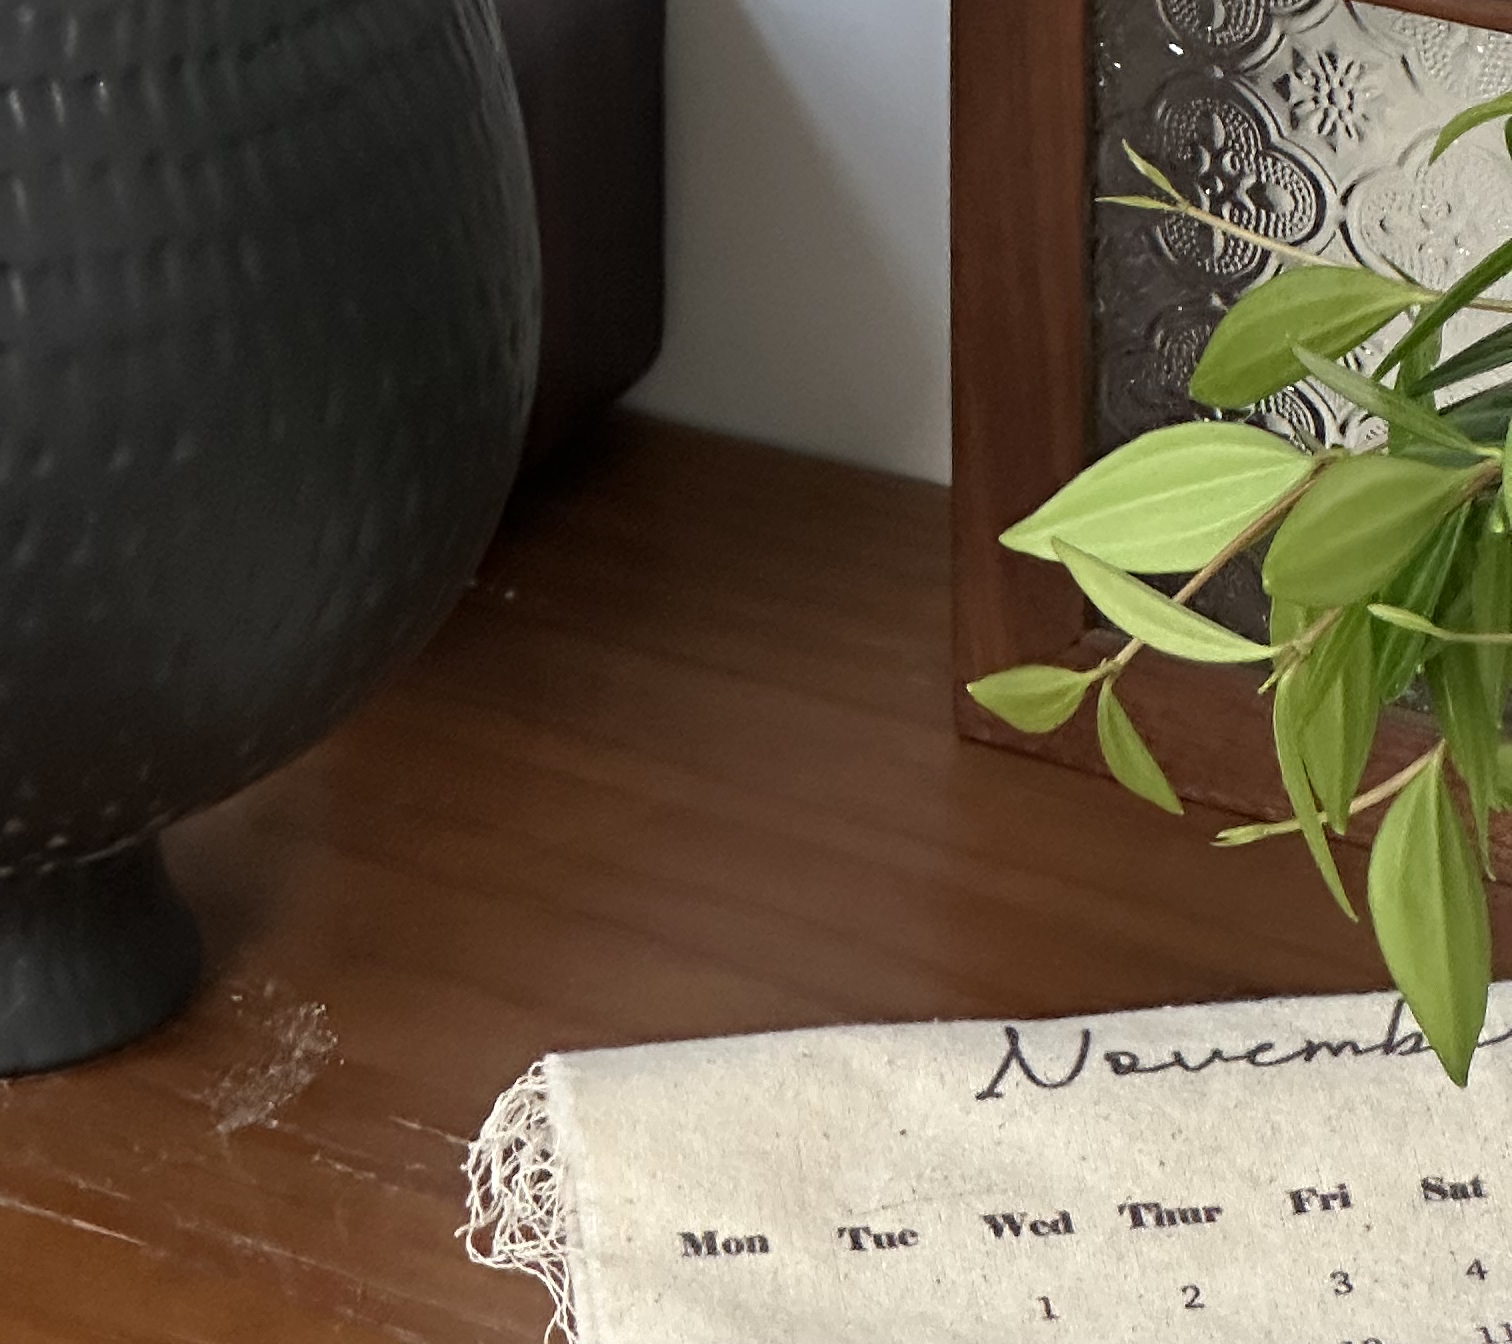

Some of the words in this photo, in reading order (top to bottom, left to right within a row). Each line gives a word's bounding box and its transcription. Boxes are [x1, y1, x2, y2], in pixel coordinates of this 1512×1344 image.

[678, 1229, 770, 1258] Mon
[837, 1226, 919, 1252] Tue
[981, 1210, 1076, 1238] Wed
[1117, 1200, 1224, 1230] Thur
[1287, 1182, 1352, 1216] Fri
[1420, 1174, 1487, 1201] Sat
[1037, 1295, 1060, 1320] 1
[1181, 1285, 1205, 1309] 2
[1330, 1270, 1353, 1296] 3
[1466, 1258, 1488, 1281] 4
